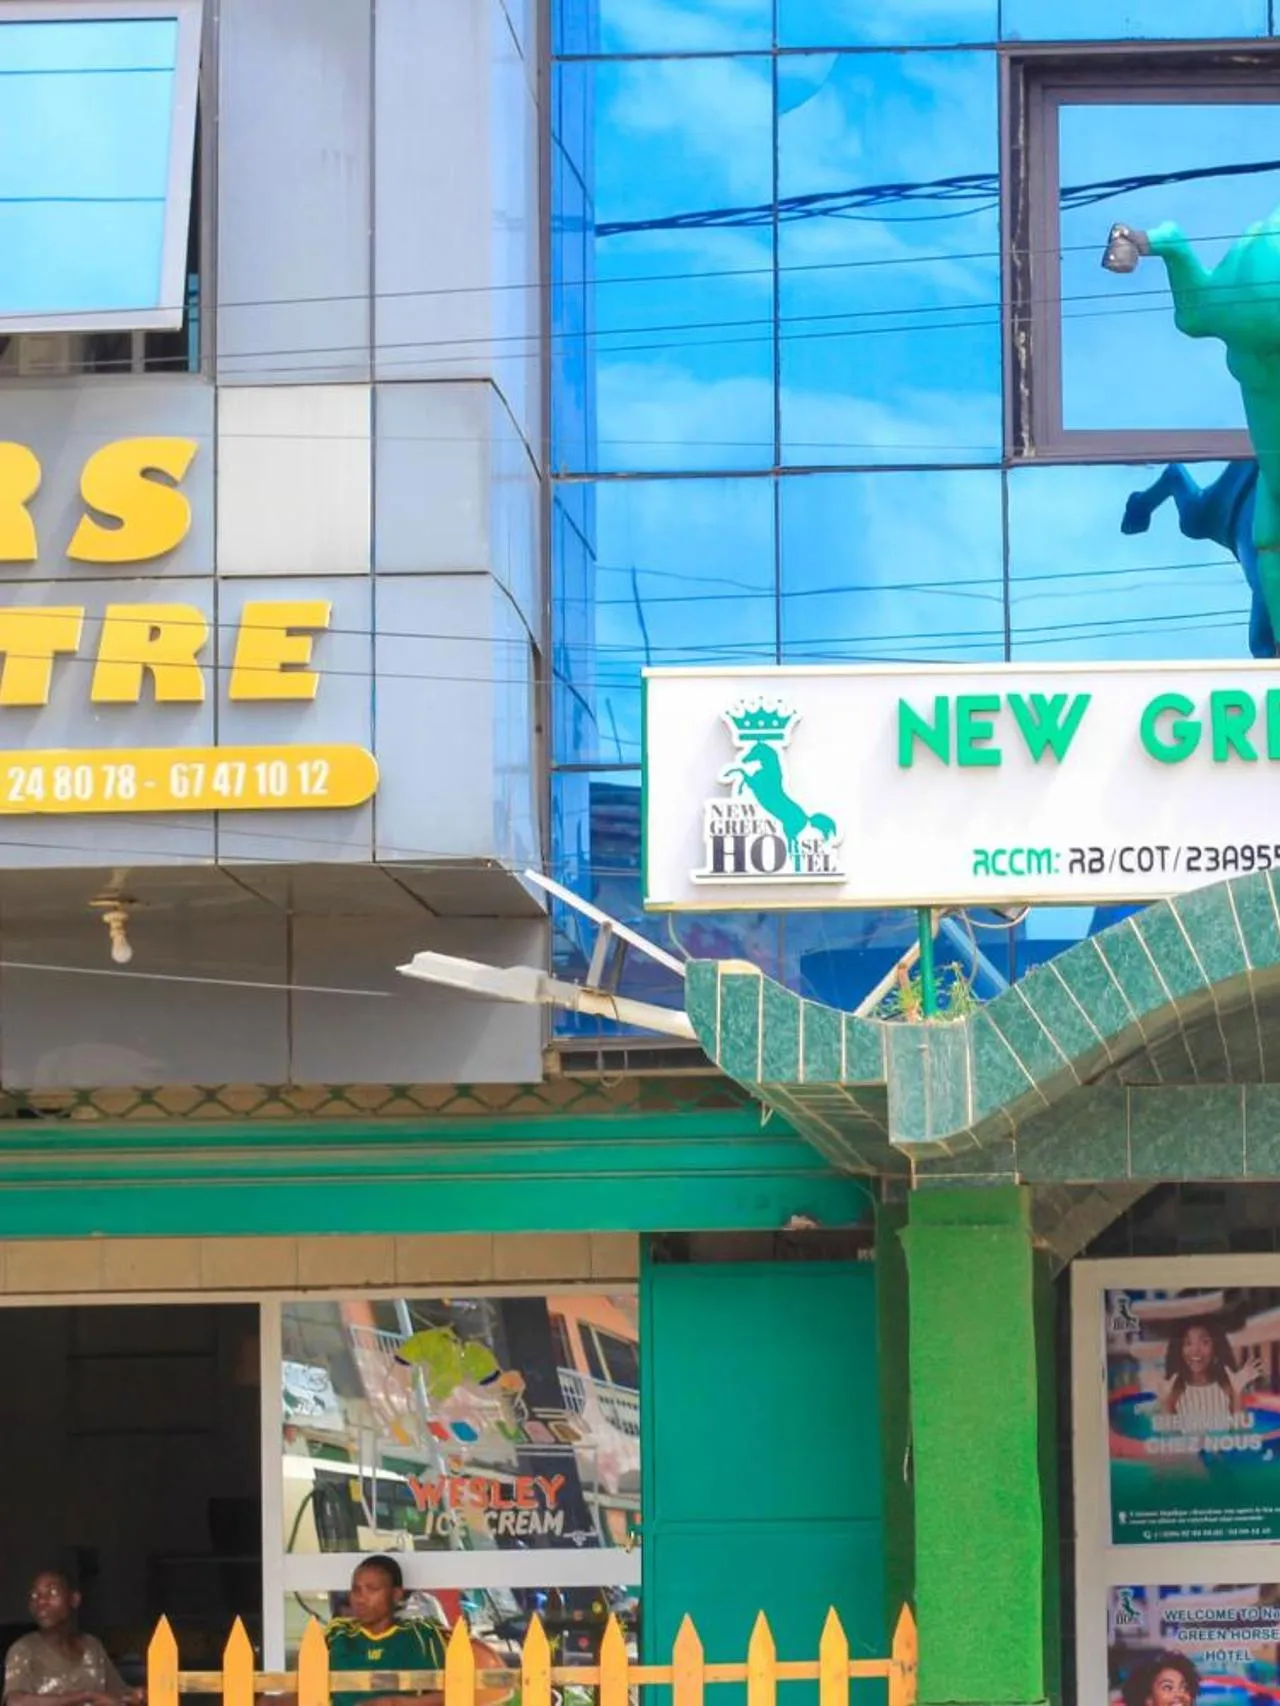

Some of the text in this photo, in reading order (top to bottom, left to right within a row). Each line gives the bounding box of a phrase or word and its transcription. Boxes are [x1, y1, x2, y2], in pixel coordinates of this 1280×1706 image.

[899, 691, 1091, 769] NEW
[7, 766, 45, 801] 24
[53, 765, 93, 800] 80
[169, 762, 205, 798] 67
[211, 761, 246, 797] 47
[254, 760, 288, 796] 10
[297, 759, 330, 795] 12
[711, 804, 756, 818] NEW
[709, 819, 777, 834] GREEN
[973, 849, 1060, 877] RCCM:
[1204, 1434, 1262, 1452] NOUS
[408, 1473, 567, 1511] WESLEY
[485, 1510, 565, 1536] CREAM
[1164, 1608, 1236, 1621] WELCOME
[1178, 1628, 1280, 1642] GREEN HORSE
